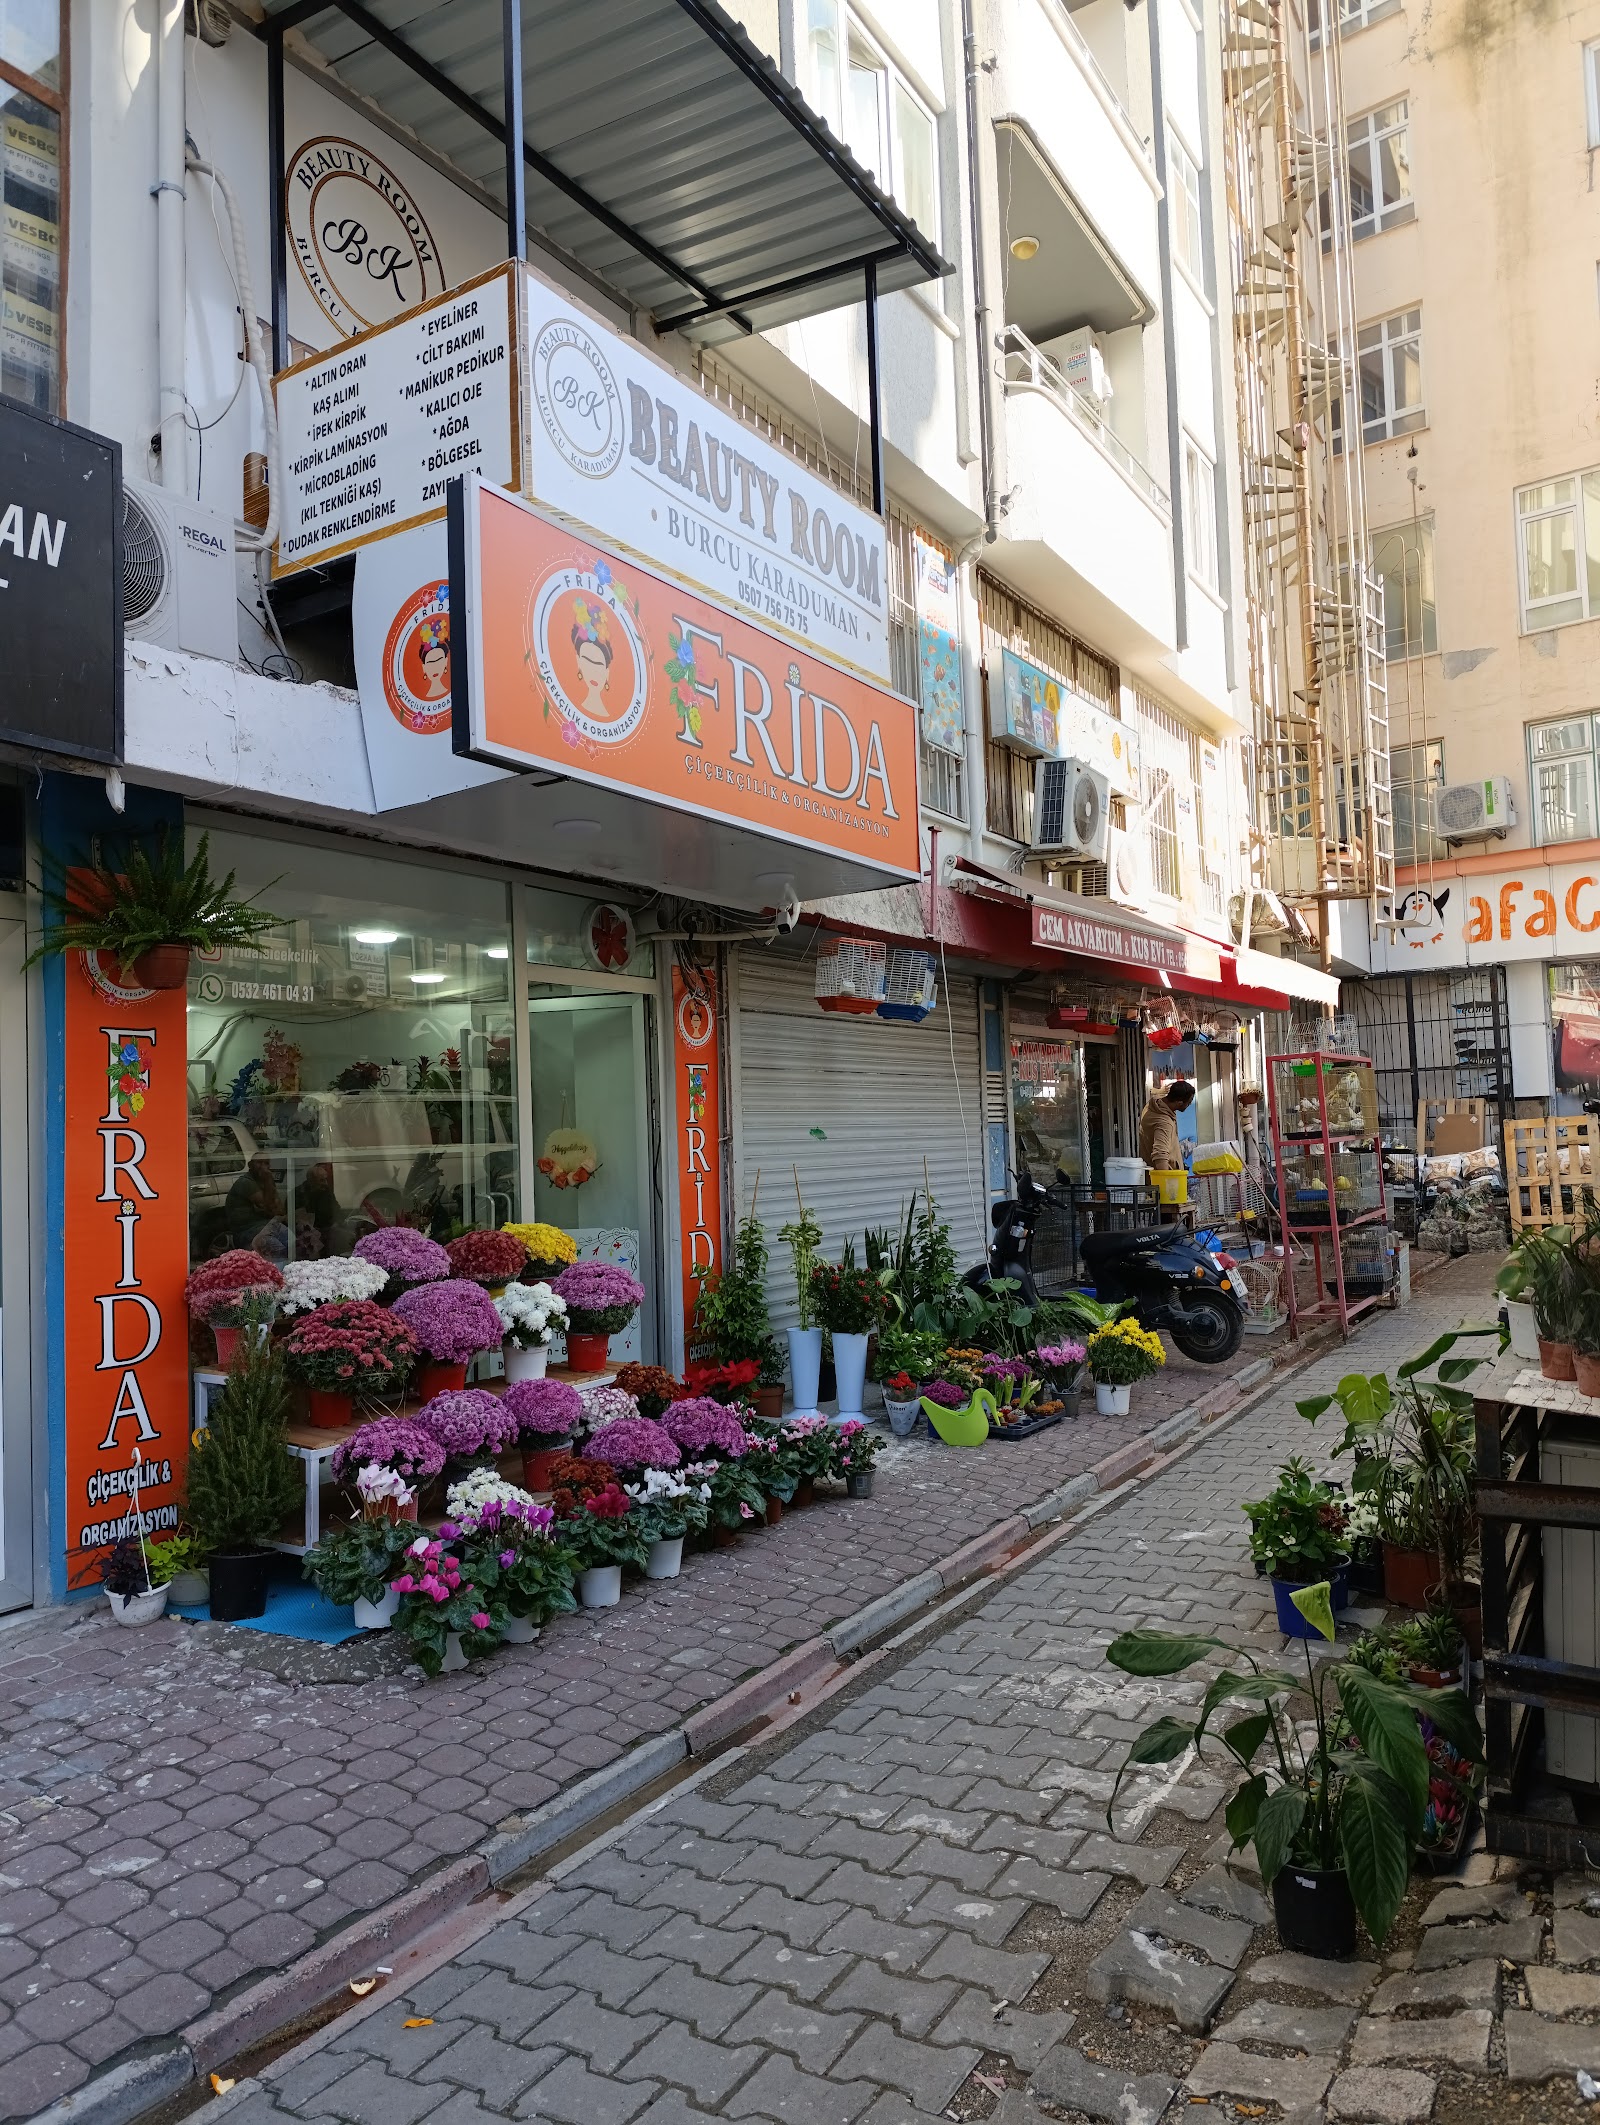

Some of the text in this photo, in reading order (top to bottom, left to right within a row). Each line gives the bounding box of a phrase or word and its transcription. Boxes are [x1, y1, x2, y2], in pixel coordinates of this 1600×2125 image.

[296, 148, 433, 263] BEAUTY ROOM
[8, 217, 58, 245] VESBO
[297, 237, 342, 318] BURCU
[428, 301, 478, 336] EYELİNER
[422, 325, 485, 365] CİLT BAKIMI
[538, 328, 616, 400] BEAUTY ROOM
[311, 353, 367, 391] ALTIN ORAN
[405, 345, 504, 400] MANİKUR PEDİKUR
[313, 383, 359, 416] KAŞ ALIMI
[426, 382, 483, 418] KALICI OJE
[312, 404, 367, 441] İPEK KİRPİK
[439, 416, 469, 440] AĞDA
[538, 395, 620, 473] BURCU KARADUMAN
[294, 448, 324, 476] KİRPİK
[325, 422, 388, 464] LAMİNASYON
[428, 438, 482, 472] BÖLGESEL
[304, 453, 377, 496] MİCROBLADİNG
[626, 378, 882, 608] BEAUTY ROOM
[301, 478, 382, 525] (KIL TEKNİĞİ KAŞ)
[183, 525, 227, 552] REGAL
[288, 499, 396, 553] DUDAK RENKLENDİRME
[667, 505, 859, 640] BURCU KARADUMAN
[414, 603, 450, 624] FRİD
[738, 579, 809, 635] 0507 756 75 75
[539, 660, 642, 738] ÇİÇEKÇİLİK & ORGANİZASYON
[684, 754, 891, 839] ÇİÇEKÇİLİK & ORGANİZASYON
[1039, 912, 1066, 945] CEM
[1067, 919, 1123, 956] AKVARYUM
[1124, 941, 1130, 957] &
[1130, 935, 1150, 964] KUŞ
[231, 982, 314, 1001] 0532 461 04 31
[1136, 1234, 1160, 1243] VOLTA
[87, 1459, 172, 1506] ÇİÇEKÇİLİK &
[81, 1504, 179, 1547] ORGANİZASYON
